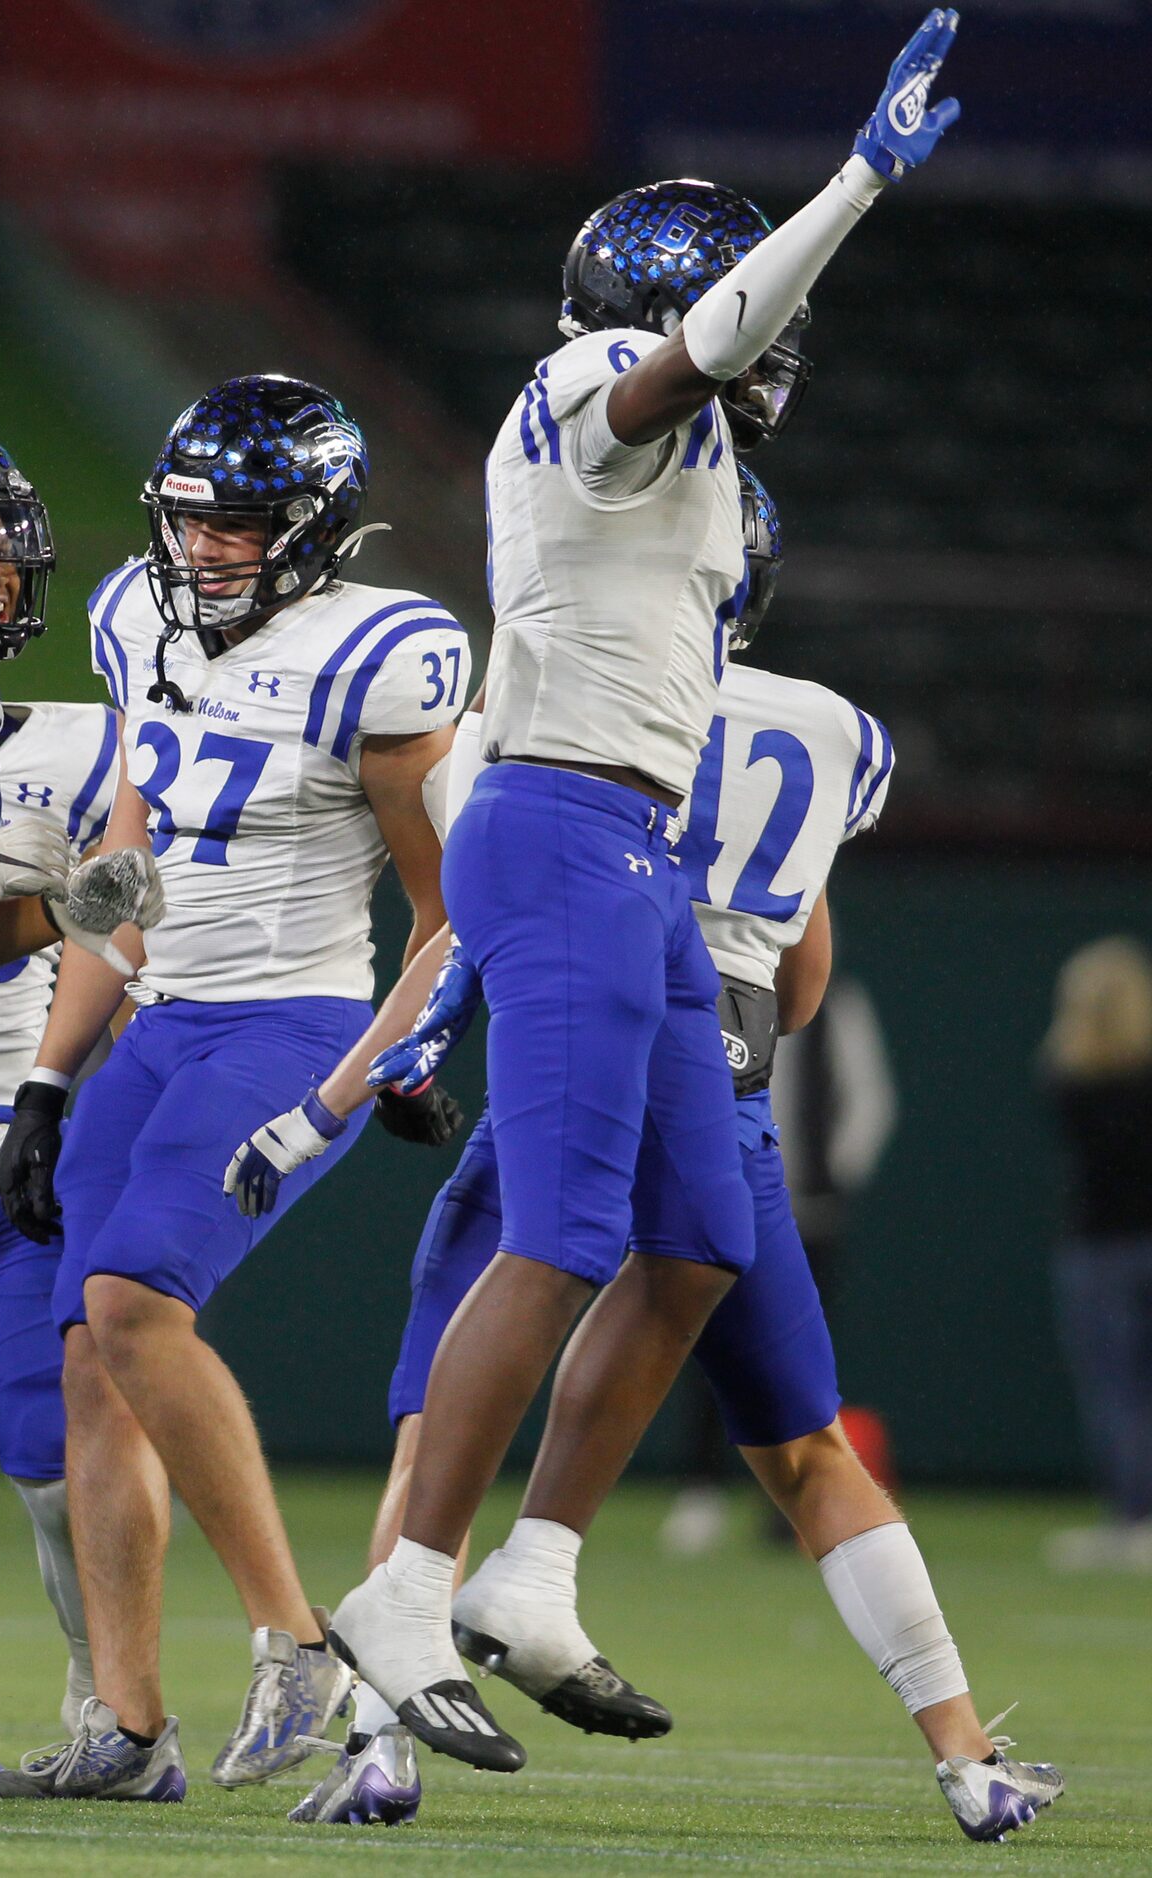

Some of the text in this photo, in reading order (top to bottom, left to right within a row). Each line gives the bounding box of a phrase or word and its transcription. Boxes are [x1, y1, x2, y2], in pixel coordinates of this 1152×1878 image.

[651, 201, 712, 254] 6
[607, 339, 641, 374] 6
[166, 478, 205, 494] Riddell
[420, 646, 462, 712] 37
[198, 696, 240, 722] Nelson
[135, 720, 275, 867] 37
[667, 714, 815, 923] 42
